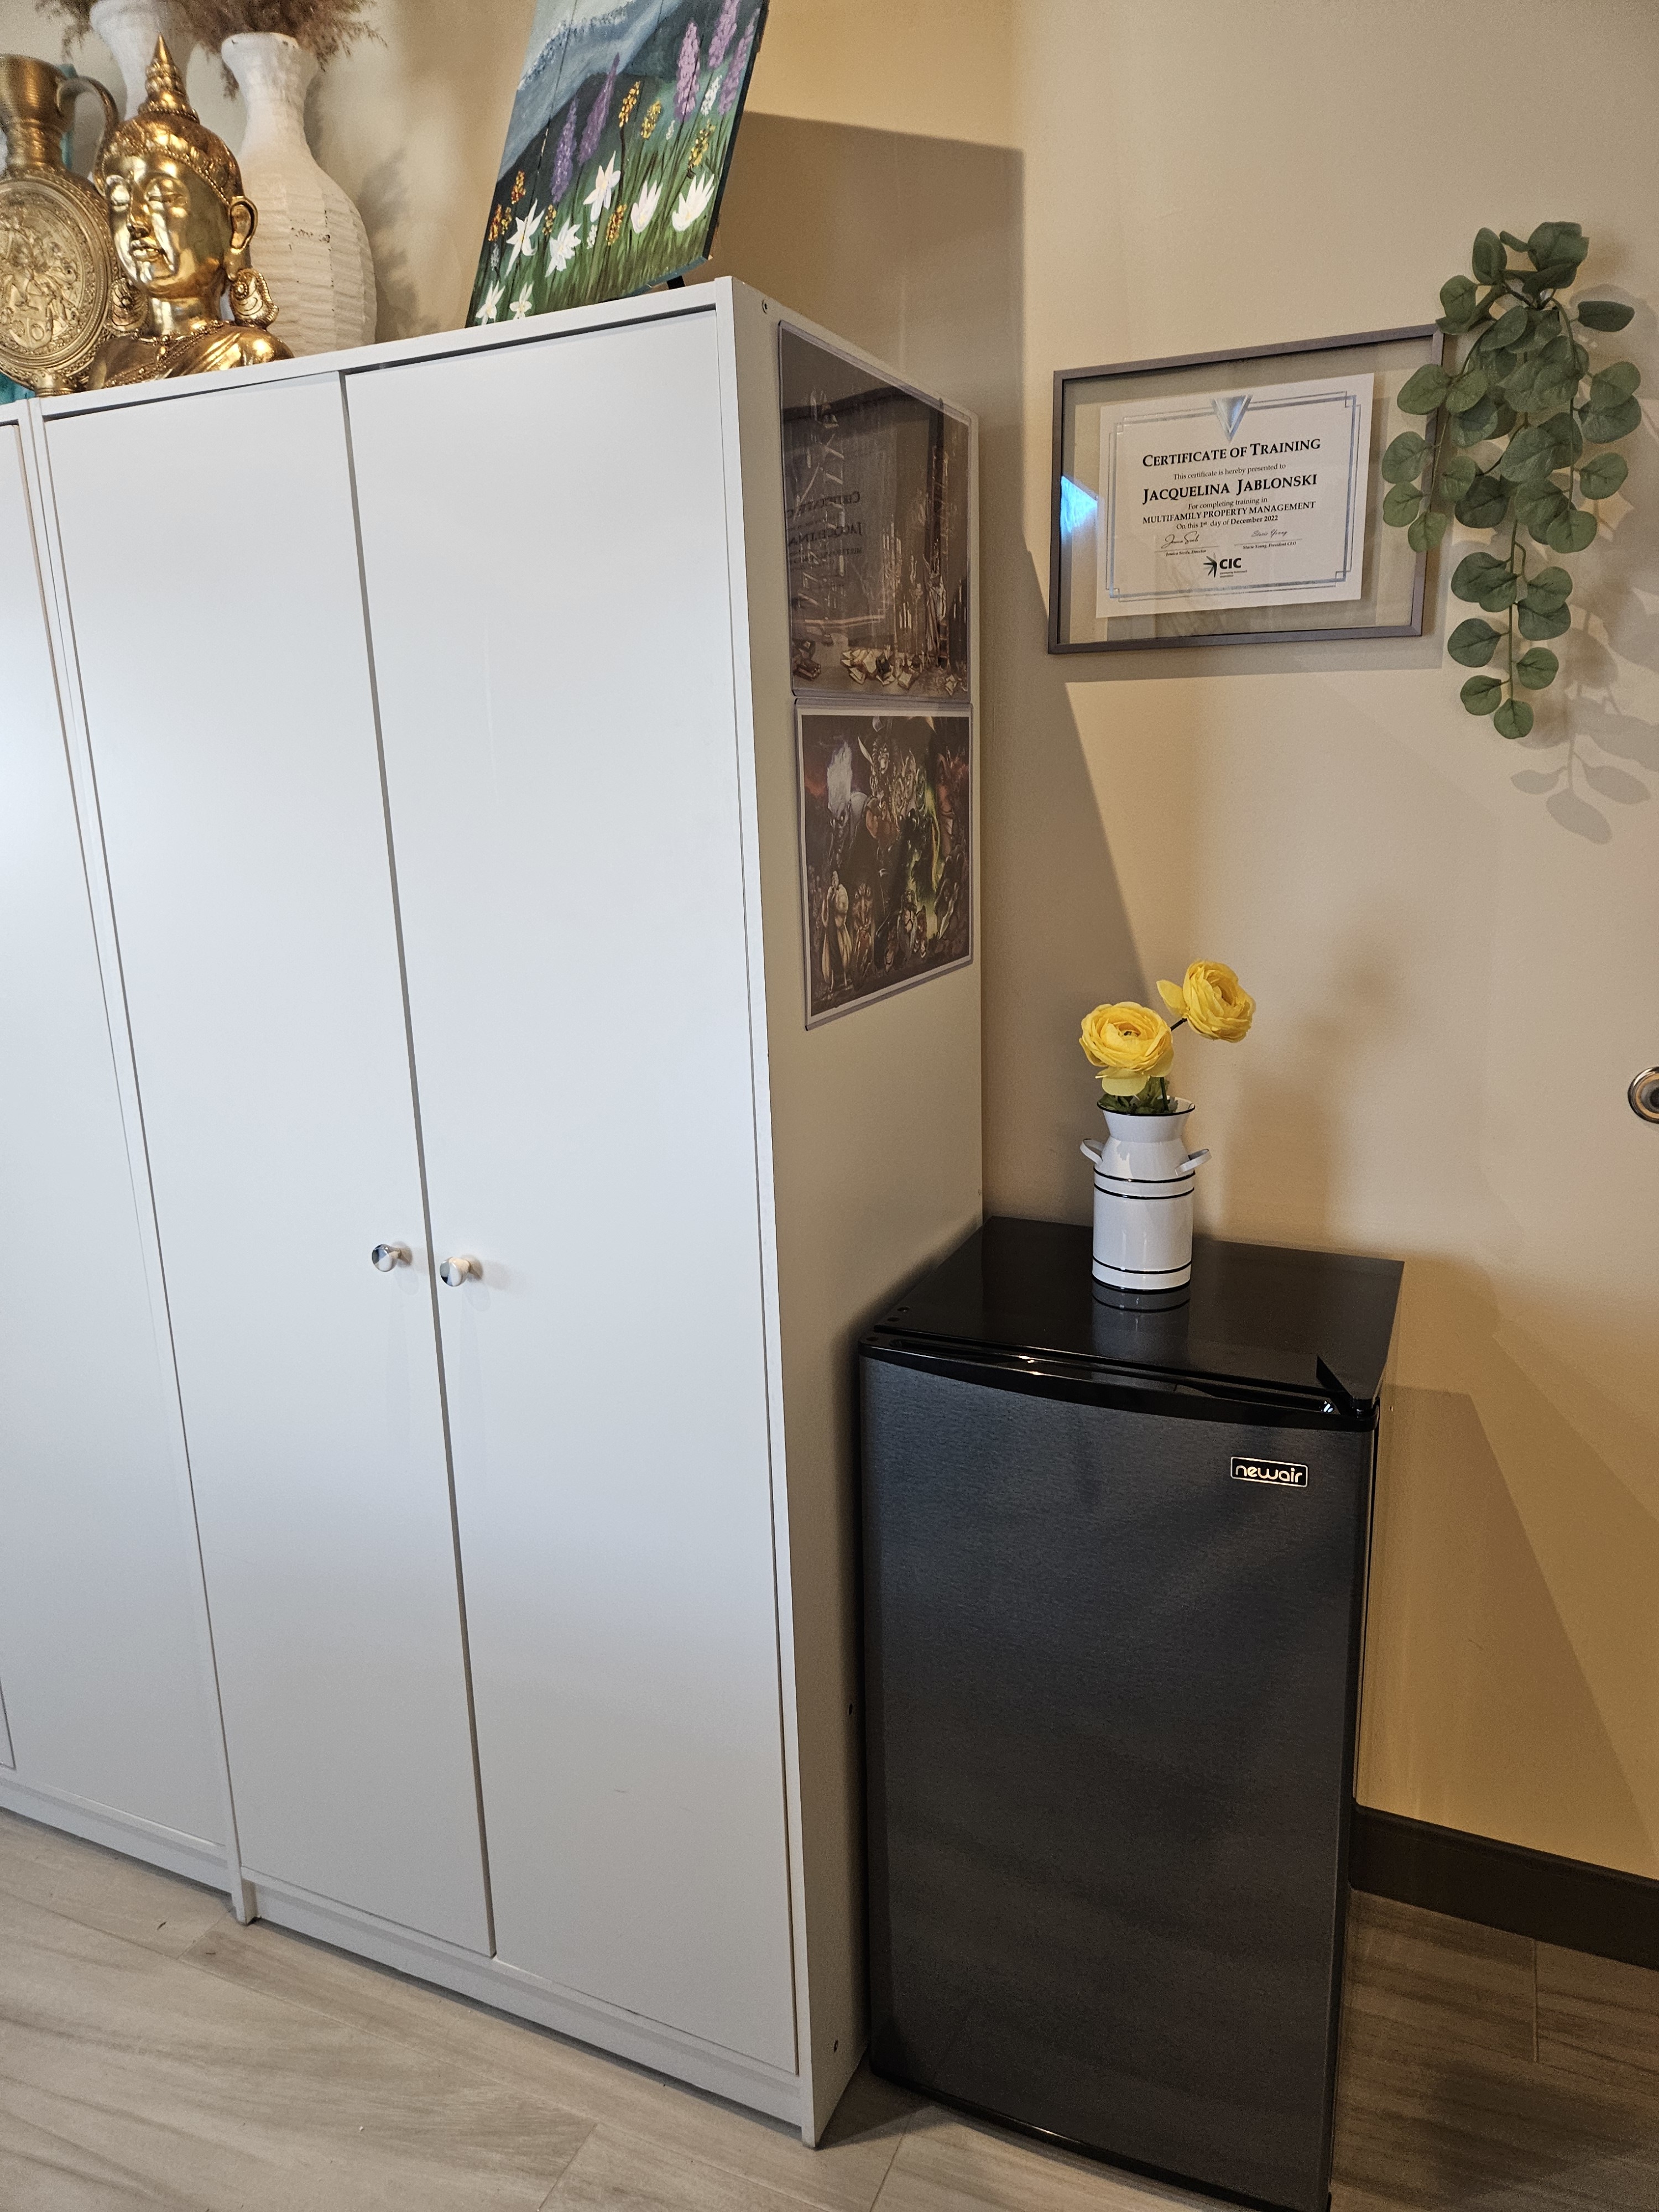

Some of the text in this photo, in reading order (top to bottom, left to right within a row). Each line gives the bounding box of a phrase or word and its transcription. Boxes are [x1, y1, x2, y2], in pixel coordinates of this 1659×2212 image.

[1142, 439, 1321, 467] CERTIFICATE OF TRAINING
[1187, 470, 1217, 479] certificate
[1225, 467, 1246, 476] hereby
[1247, 463, 1278, 474] presented
[1142, 473, 1317, 504] JACQUELINA JABLONSKI
[1199, 500, 1234, 509] completing
[1235, 497, 1260, 505] training
[1142, 501, 1316, 524] MULTIFAMILY PROPERTY MANAGEMENT
[1210, 520, 1221, 528] day
[1230, 517, 1263, 525] December
[1219, 557, 1241, 570] CIC
[1235, 1465, 1303, 1483] newair
